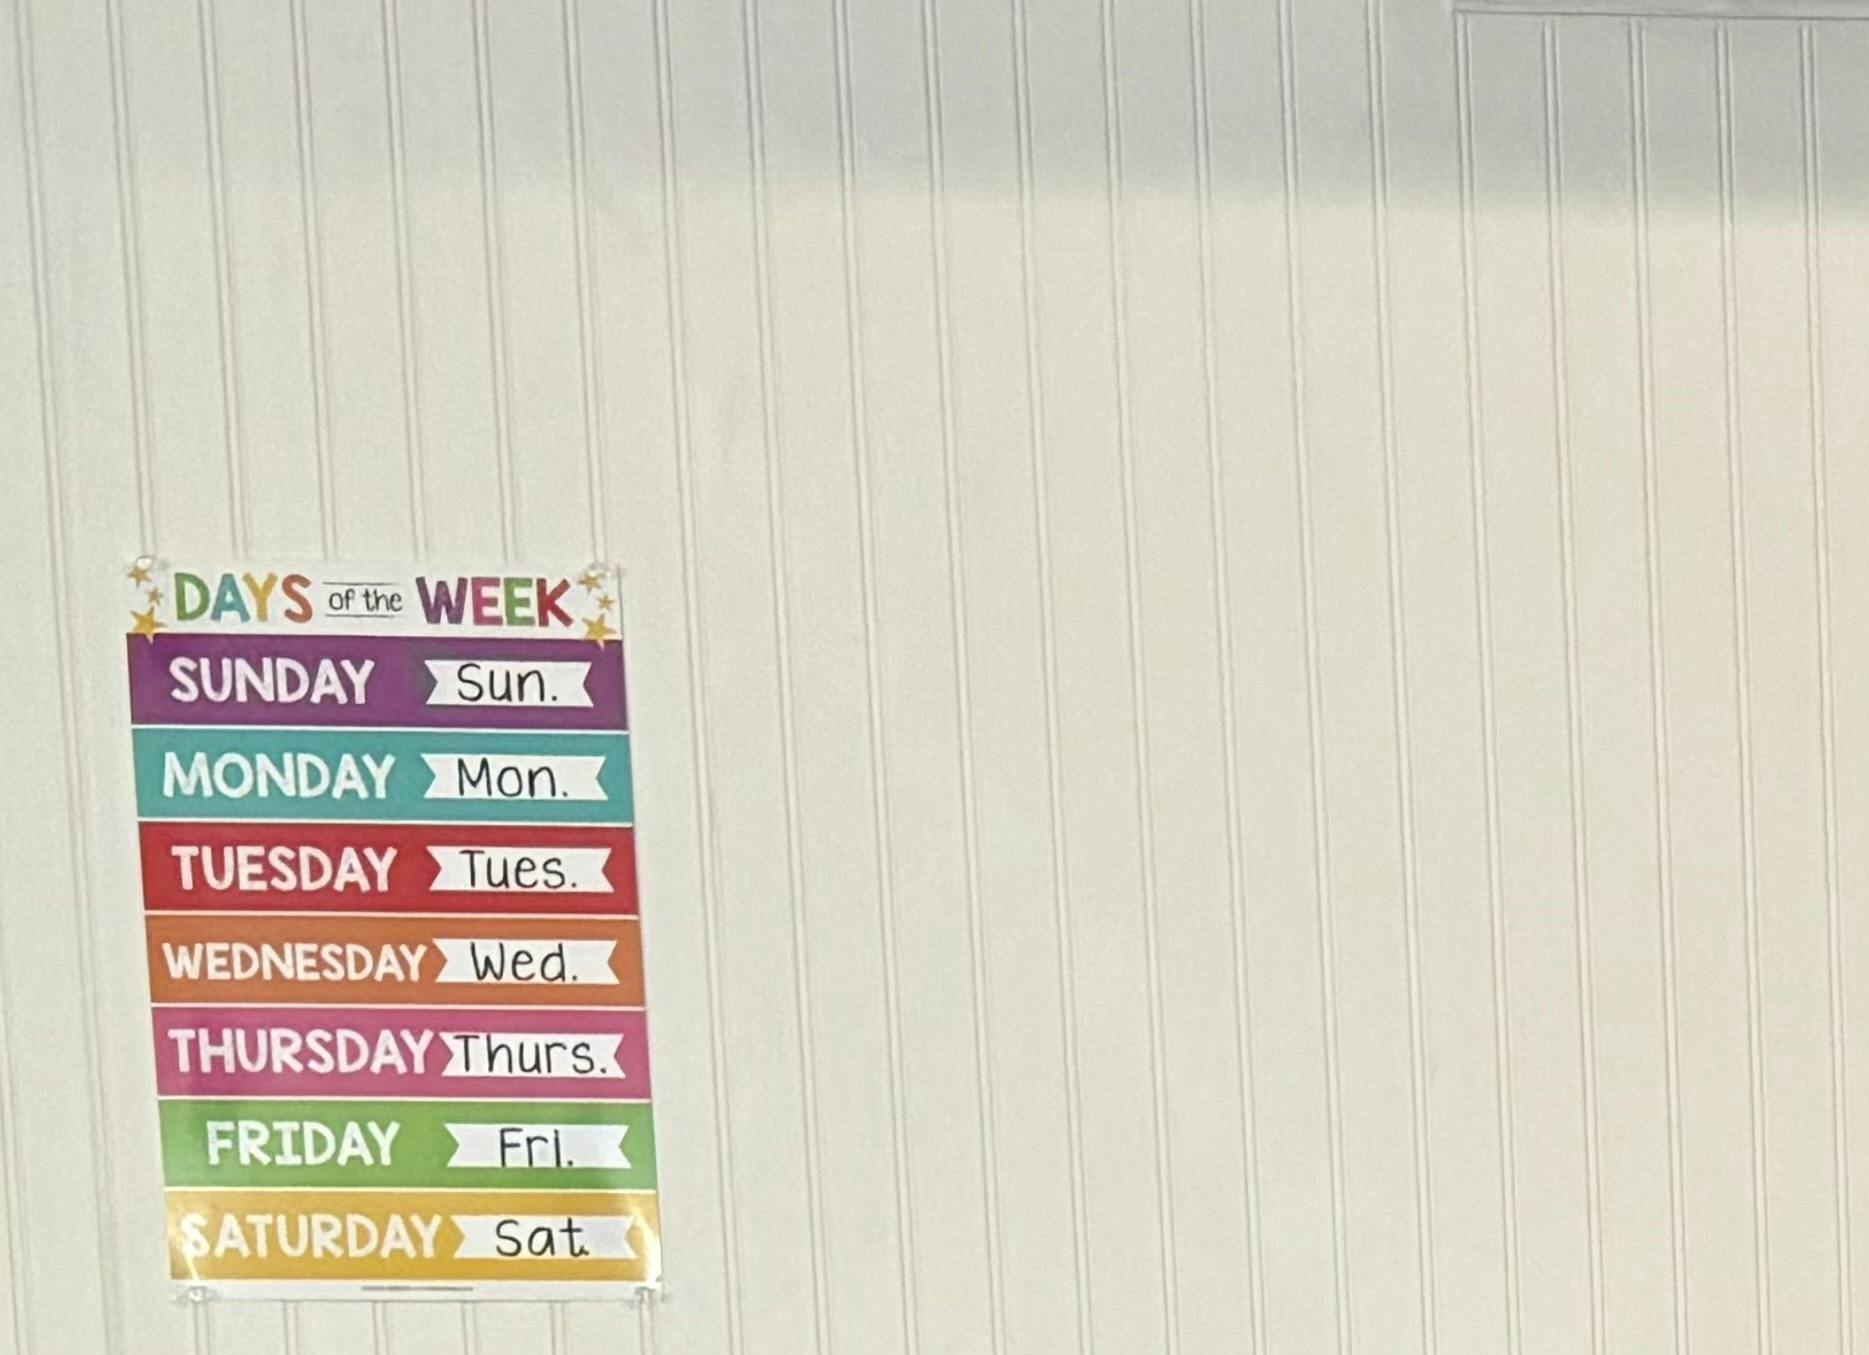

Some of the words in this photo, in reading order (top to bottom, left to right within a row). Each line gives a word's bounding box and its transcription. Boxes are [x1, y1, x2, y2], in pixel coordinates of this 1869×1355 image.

[174, 572, 314, 624] DAYS
[328, 589, 357, 613] of
[362, 583, 403, 613] the
[416, 576, 572, 628] WEEK
[170, 657, 375, 704] SUNDAY
[456, 662, 558, 702] Sun.
[162, 752, 395, 800] MONDAY
[456, 757, 568, 799] Mon.
[171, 845, 397, 893] TUESDAY
[464, 850, 578, 890] Tues.
[162, 942, 427, 982] WEDNESDAY
[470, 941, 578, 983] Wed.
[167, 1028, 435, 1075] THURSDAY
[452, 1035, 607, 1075] Thurs.
[206, 1120, 400, 1168] FRIDAY
[500, 1127, 574, 1168] Fri.
[180, 1213, 442, 1259] SATURDAY
